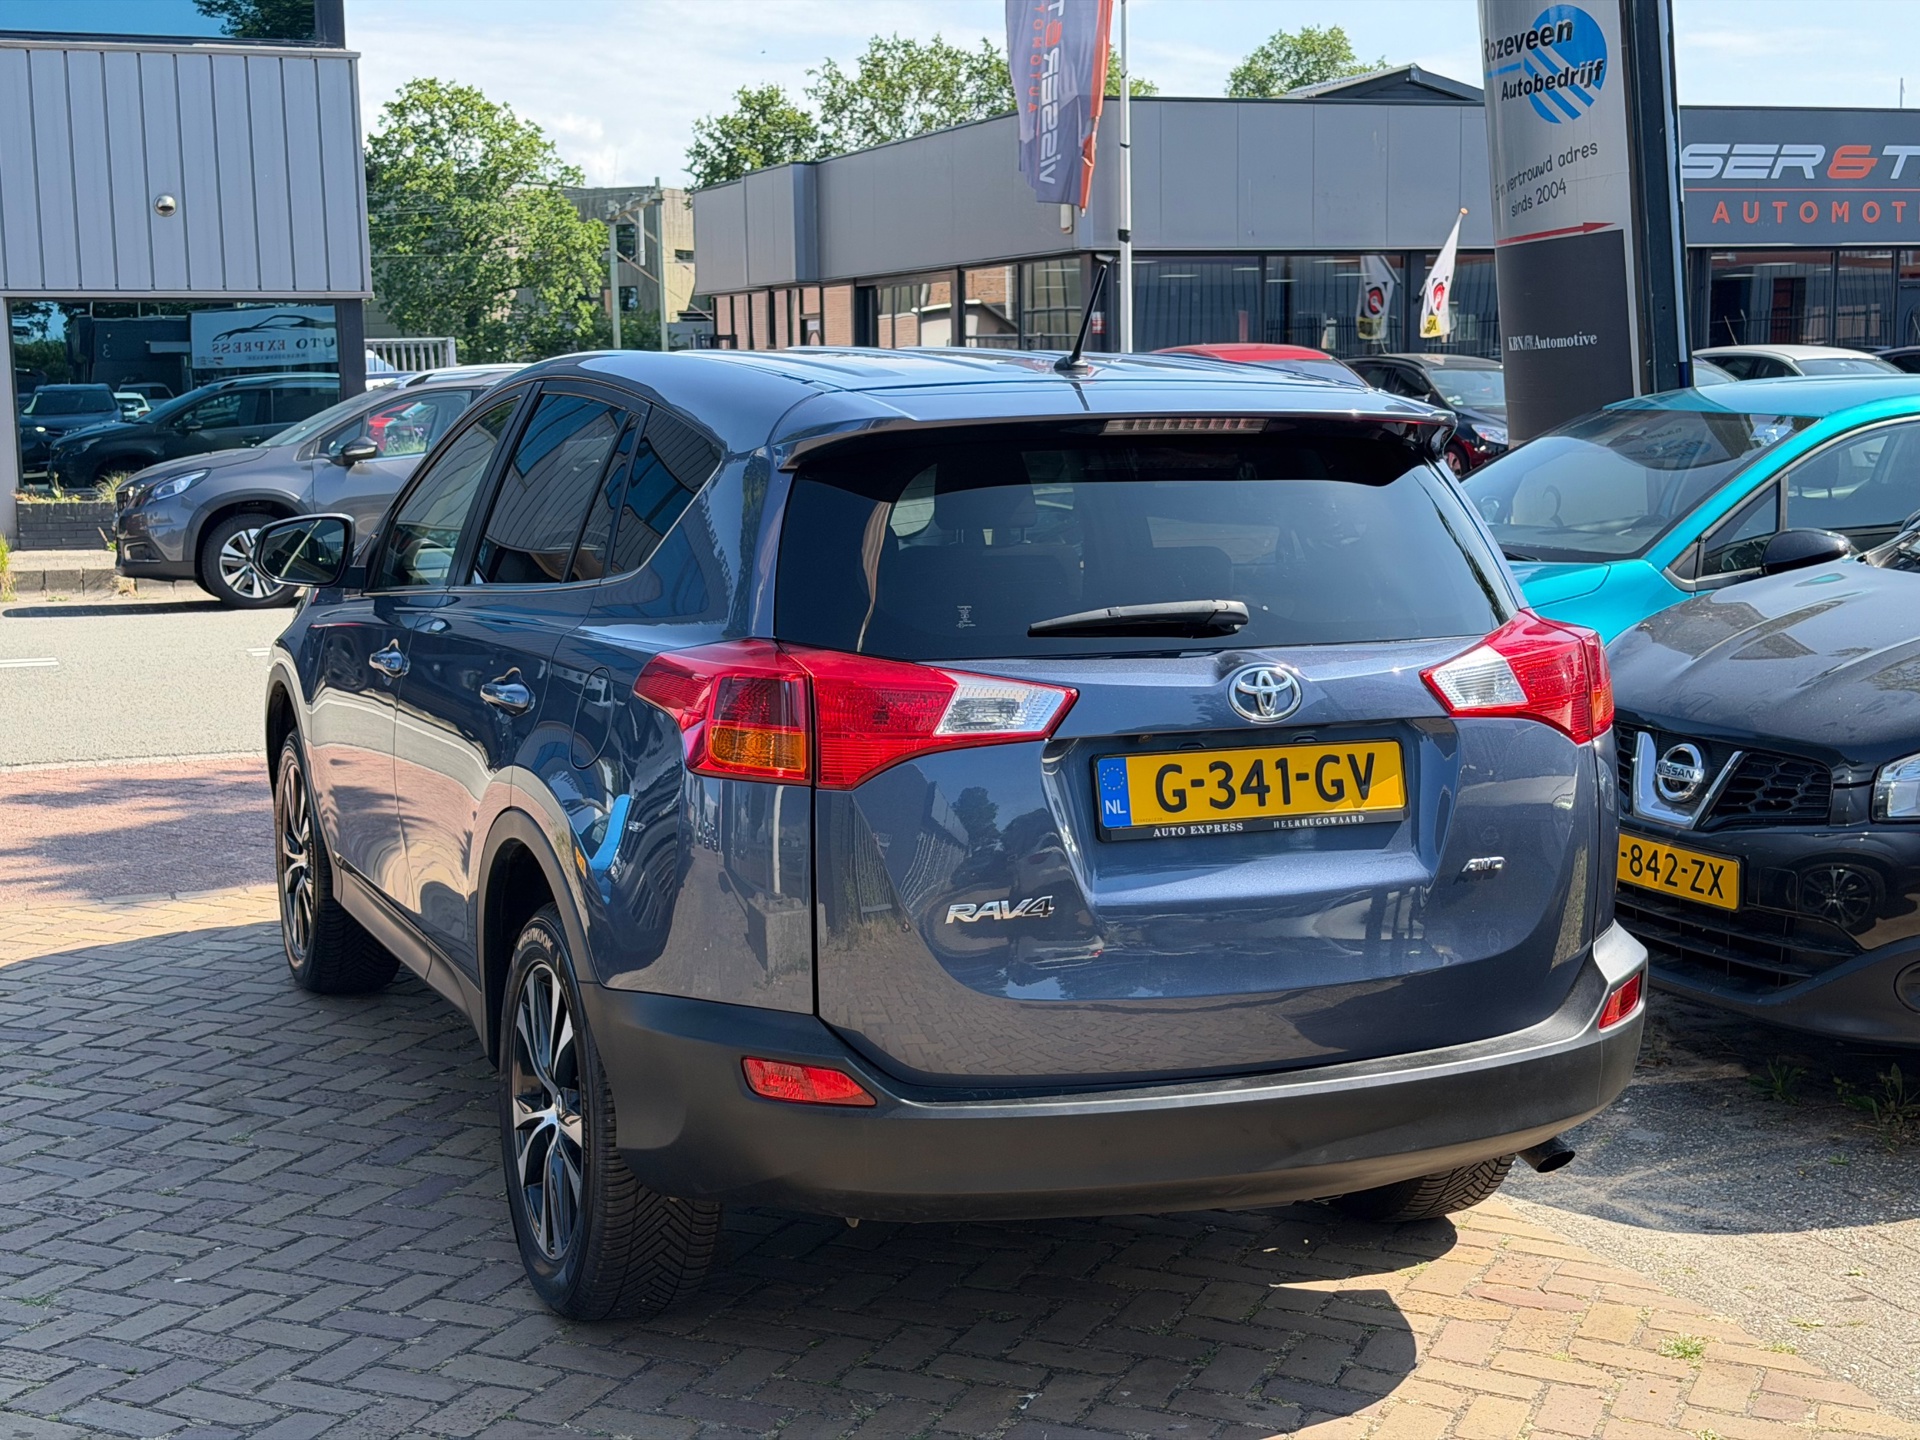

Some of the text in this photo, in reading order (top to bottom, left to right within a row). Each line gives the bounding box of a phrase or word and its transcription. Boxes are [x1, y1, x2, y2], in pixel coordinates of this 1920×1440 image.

[1485, 20, 1573, 63] Rozeveen
[1501, 60, 1604, 101] Autobedrijf
[1506, 154, 1553, 191] vertrouwd
[1558, 142, 1598, 167] adres
[1511, 178, 1567, 217] sinds 2004
[1711, 201, 1920, 224] AUTOMOT
[1155, 752, 1375, 814] G-341-GV
[1658, 763, 1695, 779] NISSAN
[1104, 799, 1127, 815] NL
[1153, 815, 1365, 838] AUTO EXPRESS HEERHUGOWAARD
[945, 895, 1055, 924] RAV4
